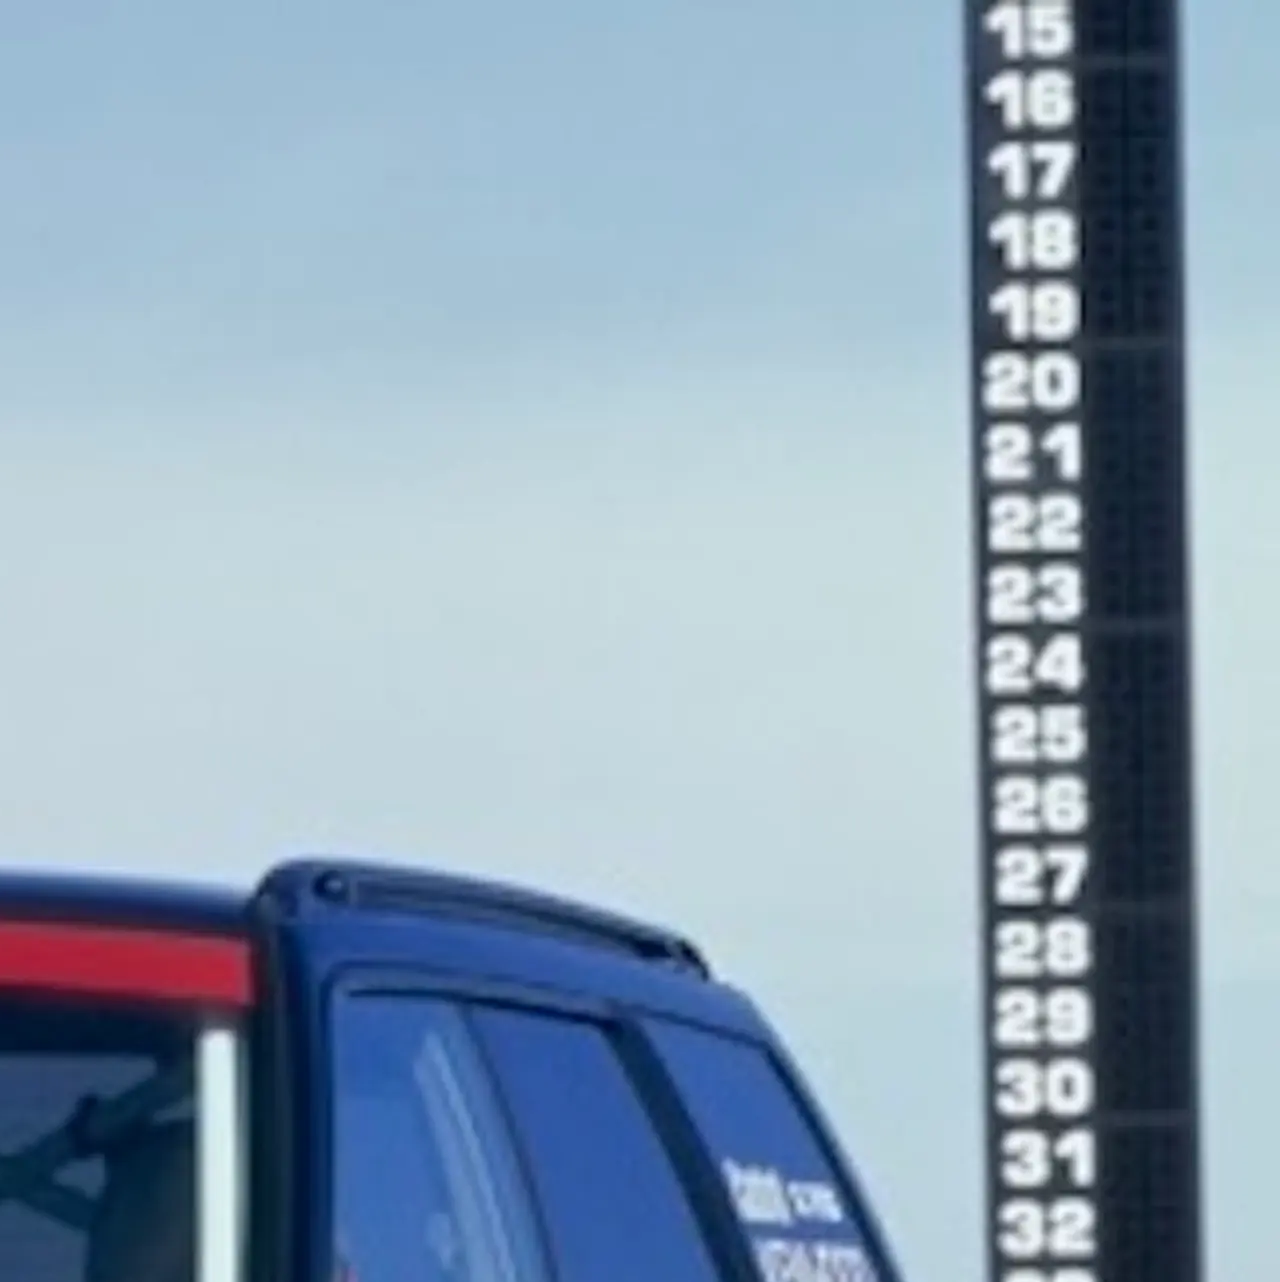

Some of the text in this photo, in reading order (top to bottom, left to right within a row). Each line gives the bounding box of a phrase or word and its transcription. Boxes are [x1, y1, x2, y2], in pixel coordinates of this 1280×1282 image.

[986, 0, 1072, 58] 15
[987, 70, 1074, 128] 16
[988, 142, 1074, 198] 17
[990, 209, 1077, 269] 18
[990, 281, 1079, 340] 19
[983, 352, 1079, 410] 20
[985, 423, 1081, 481] 21
[989, 493, 1081, 551] 22
[988, 564, 1082, 623] 23
[986, 634, 1083, 693] 24
[992, 705, 1086, 763] 25
[994, 774, 1087, 833] 26
[996, 846, 1087, 904] 27
[996, 918, 1090, 977] 28
[995, 988, 1091, 1046] 29
[996, 1058, 1093, 1116] 30
[1003, 1130, 1094, 1187] 31
[1000, 1198, 1094, 1257] 32
